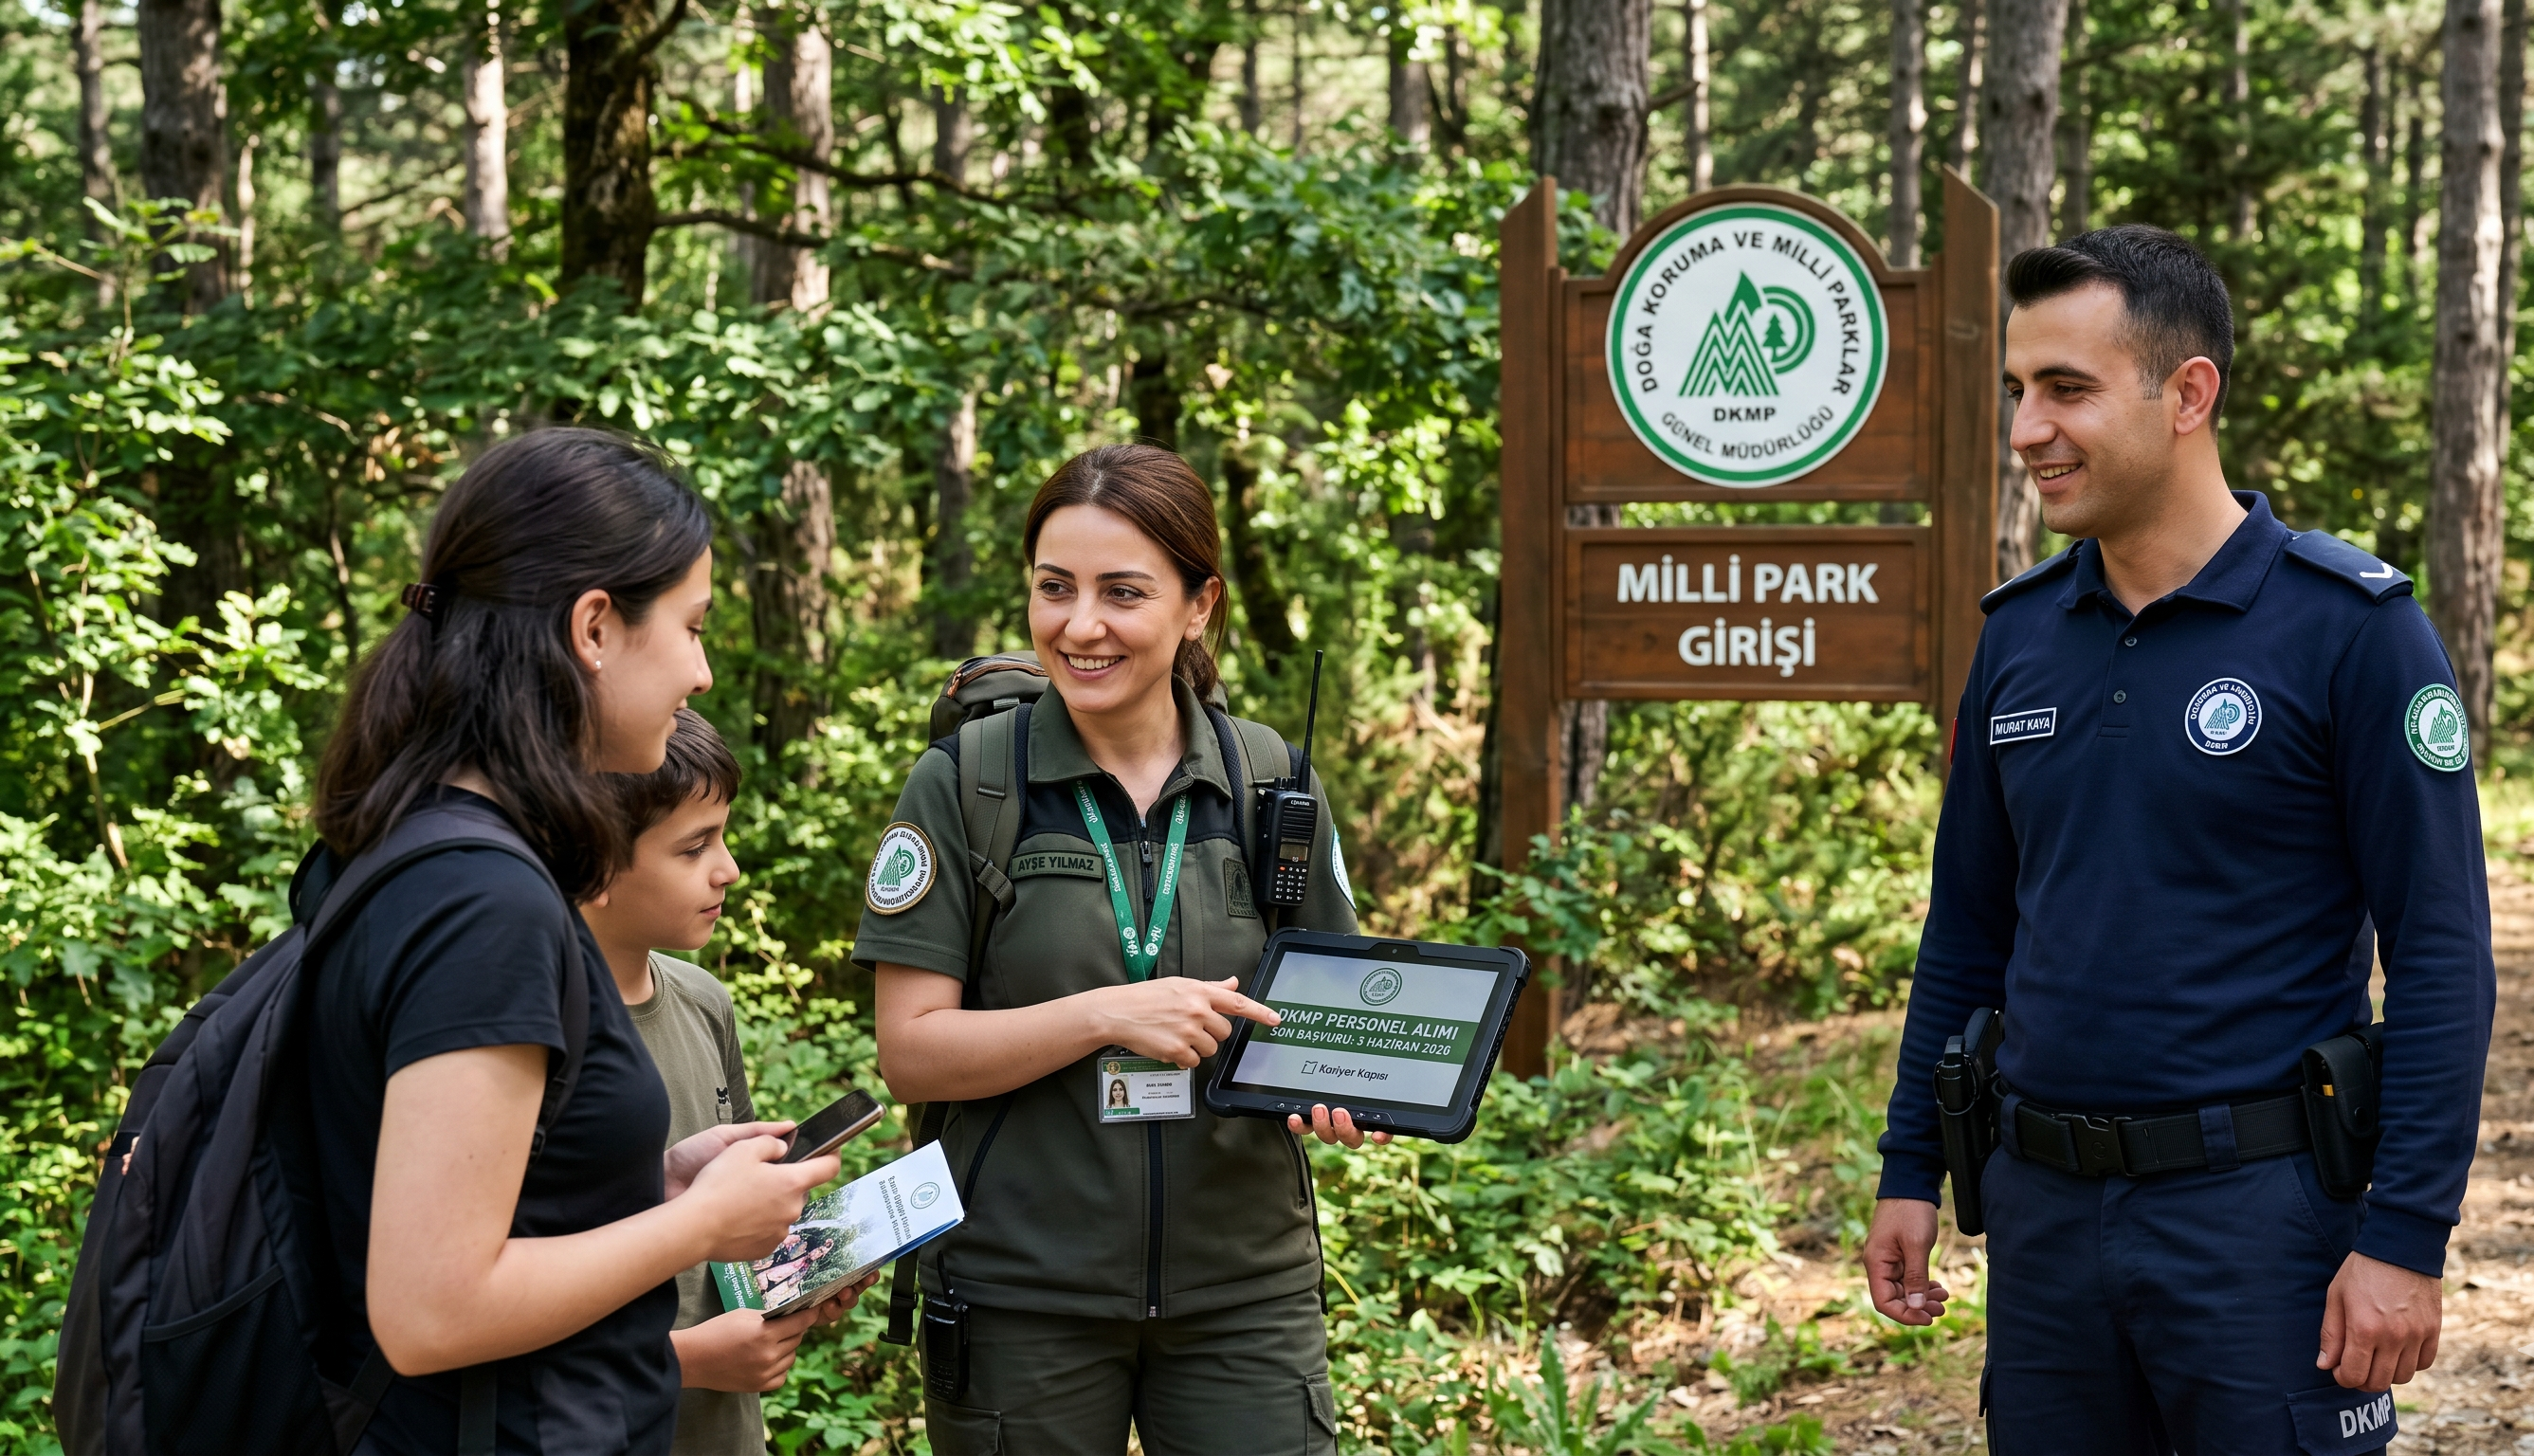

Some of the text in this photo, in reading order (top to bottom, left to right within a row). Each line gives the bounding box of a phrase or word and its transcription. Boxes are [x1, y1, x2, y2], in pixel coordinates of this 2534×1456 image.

[1733, 231, 1763, 248] VE
[1642, 237, 1725, 316] KORUMA
[1827, 281, 1859, 395] PARKLAR
[1631, 324, 1658, 393] DOĞA
[1713, 407, 1777, 423] DKMP
[1721, 405, 1834, 460] MÜDÜRLÜĞÜ
[1616, 554, 1880, 604] MİLLİ PARK
[1677, 616, 1816, 678] GİRİŞİ
[1995, 717, 2050, 736] MURAT KAYA
[1018, 856, 1094, 872] AYŞE YILMAZ
[1269, 1027, 1295, 1038] SON
[1296, 1029, 1355, 1046] BAŞVURU:
[1366, 1037, 1420, 1052] HAZİRAN
[1278, 1008, 1460, 1041] DKMP PERSONEL ALIMI
[1319, 1064, 1389, 1082] Kariyer Kapısı
[2339, 1392, 2392, 1439] DKMP
